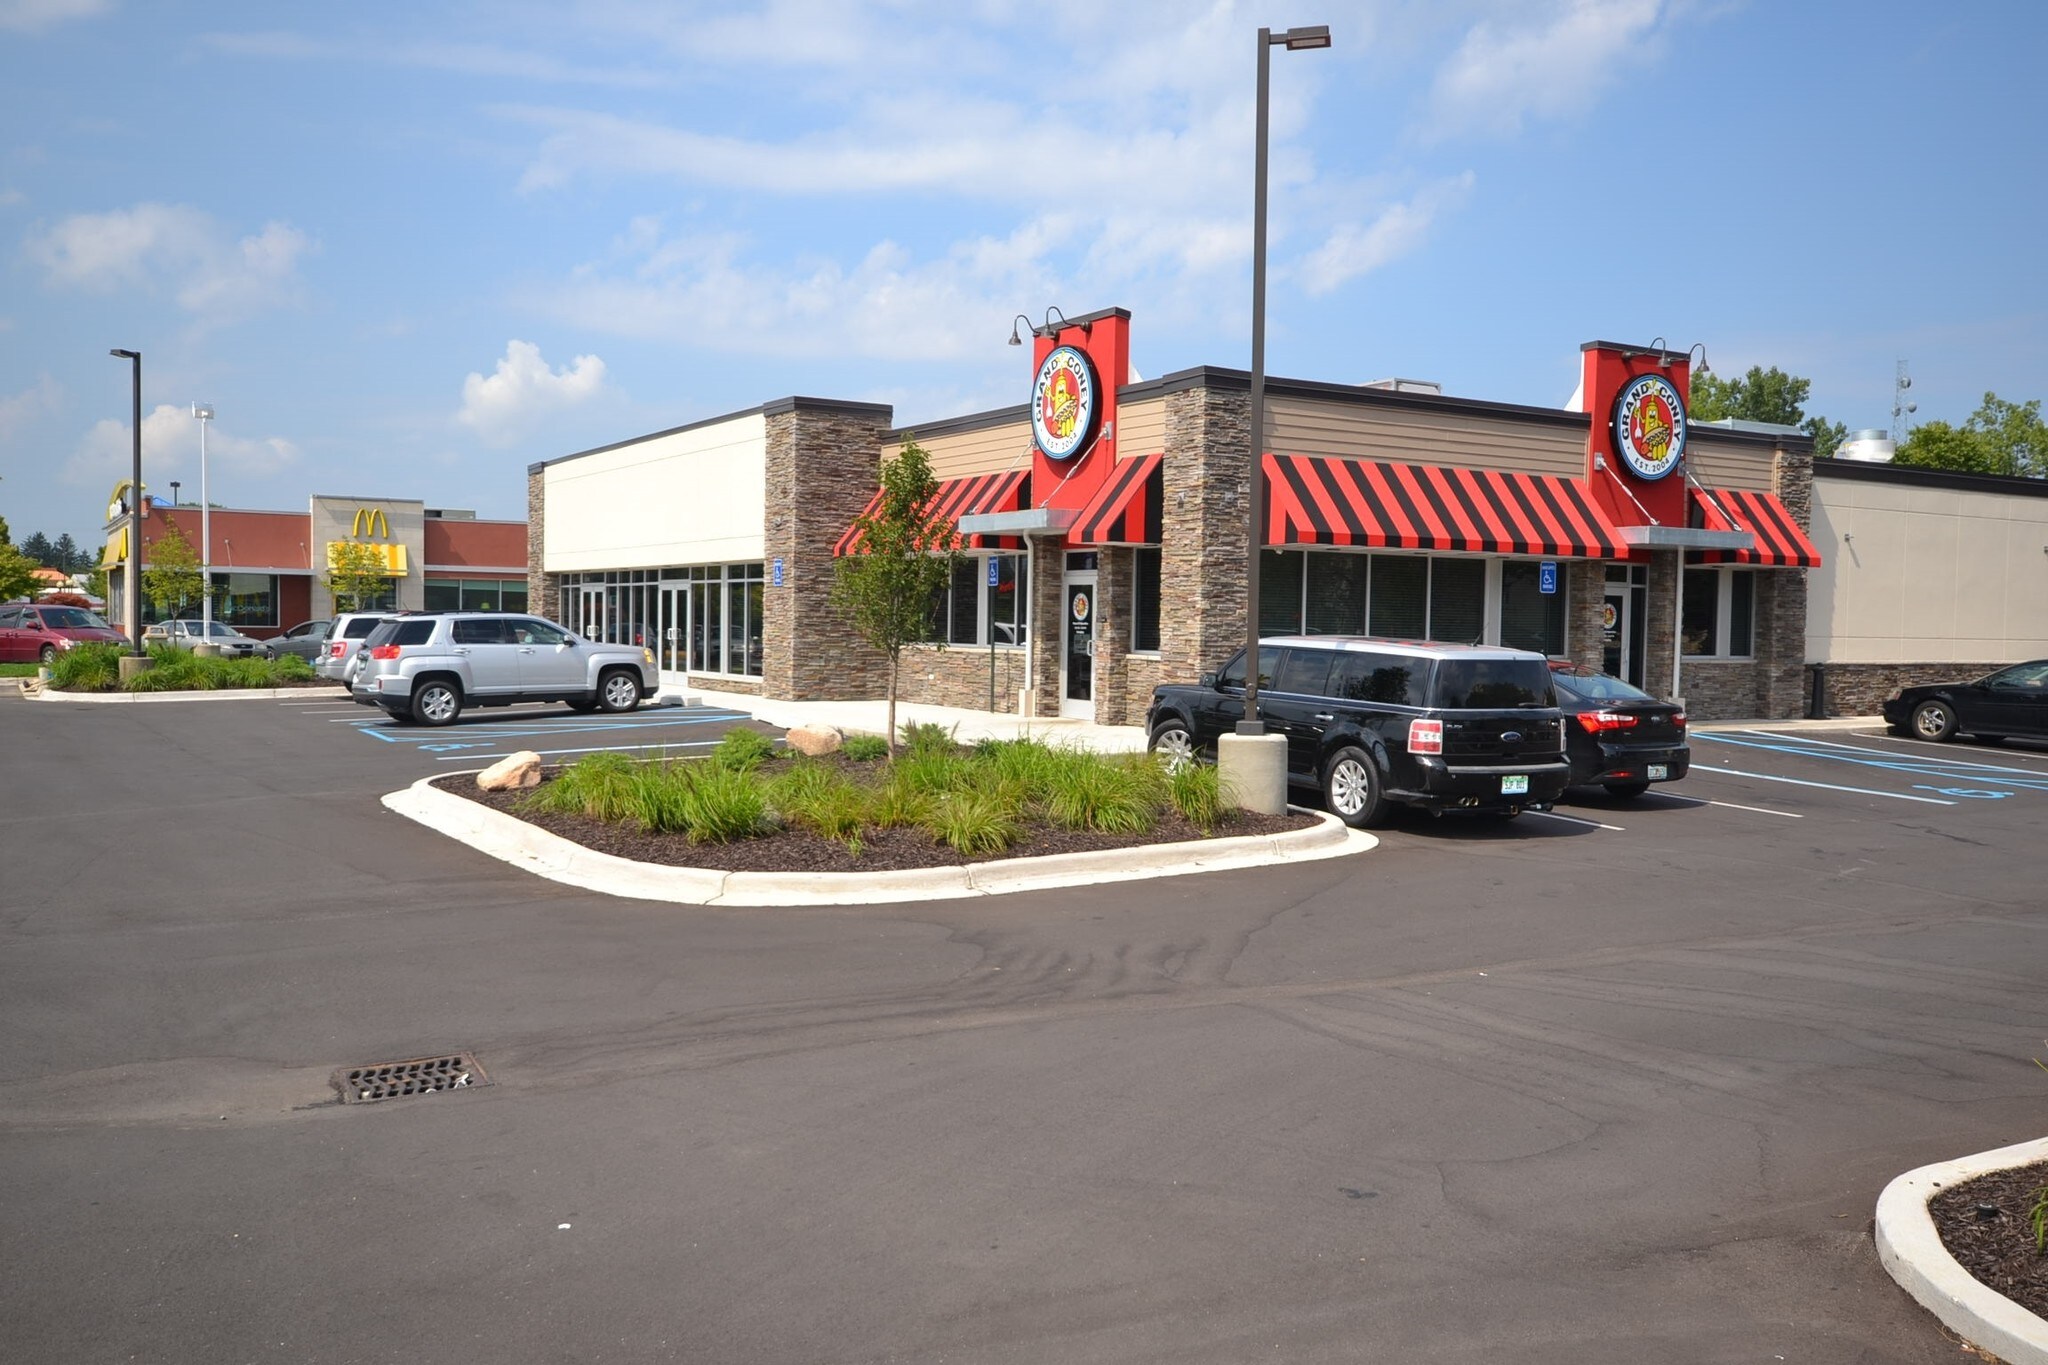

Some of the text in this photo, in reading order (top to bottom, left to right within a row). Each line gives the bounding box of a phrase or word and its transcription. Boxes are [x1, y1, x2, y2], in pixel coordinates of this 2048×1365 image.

[1035, 356, 1088, 423] GRAND CONEY
[1621, 382, 1683, 443] GRAND CONEY
[1634, 457, 1670, 472] EST. 2004
